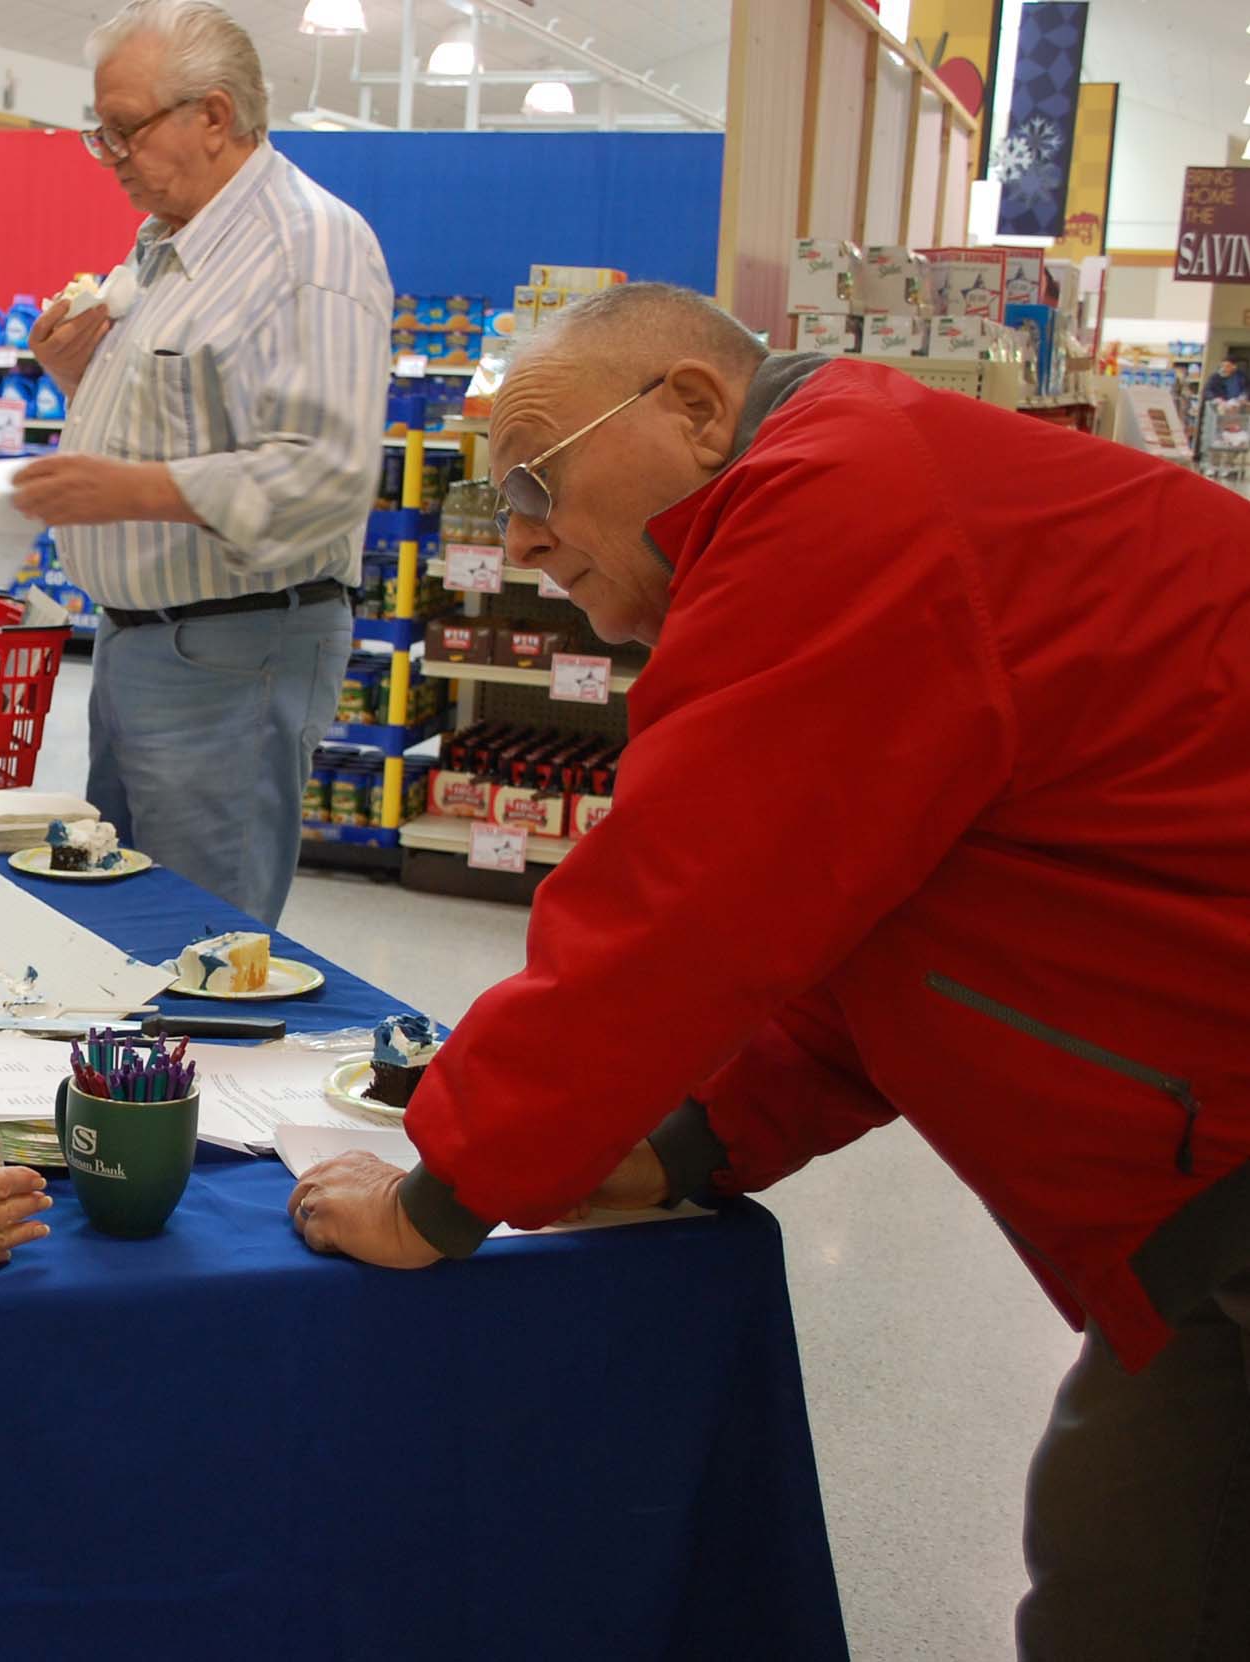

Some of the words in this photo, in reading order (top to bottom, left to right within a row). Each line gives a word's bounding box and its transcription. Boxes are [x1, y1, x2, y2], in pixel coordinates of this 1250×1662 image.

[1186, 170, 1234, 187] BRING
[1185, 187, 1236, 206] HOME
[1184, 207, 1215, 225] THE
[94, 1159, 127, 1177] Bank
